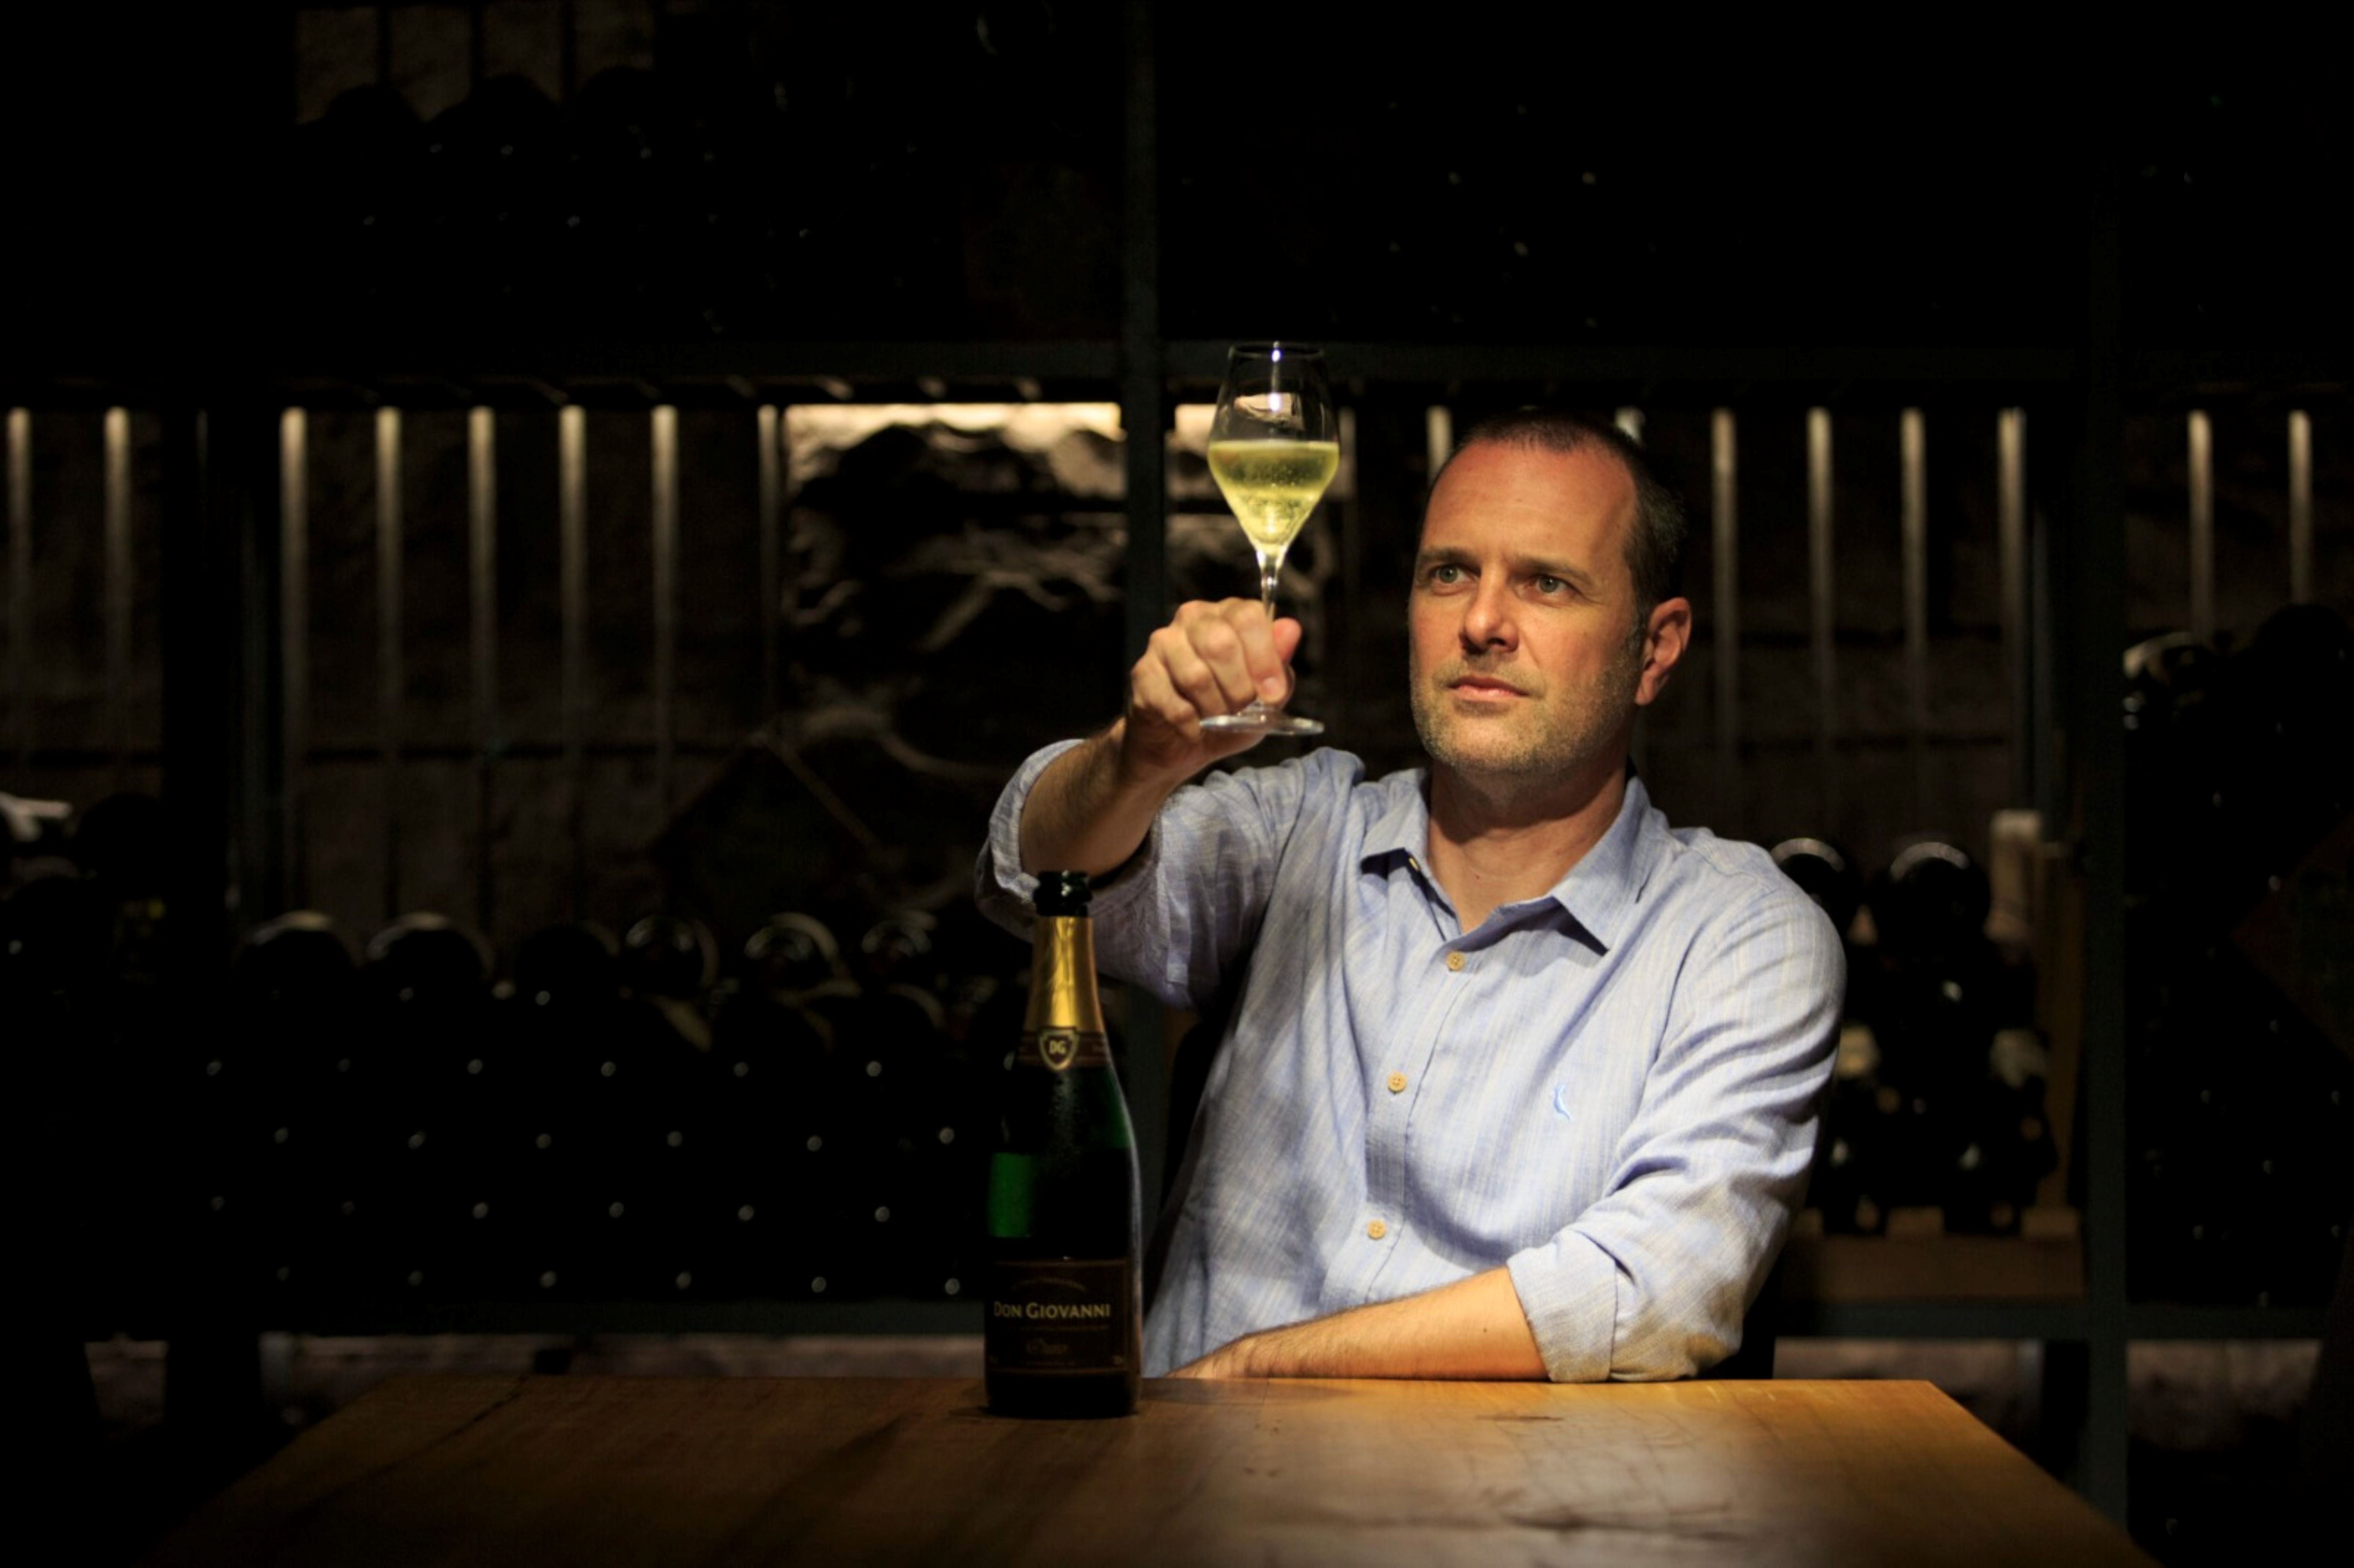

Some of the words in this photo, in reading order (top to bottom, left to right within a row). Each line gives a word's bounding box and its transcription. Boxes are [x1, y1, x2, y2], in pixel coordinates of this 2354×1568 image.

[1049, 1040, 1066, 1054] DG
[993, 1301, 1022, 1318] DON
[1026, 1302, 1111, 1318] GIOVANNI
